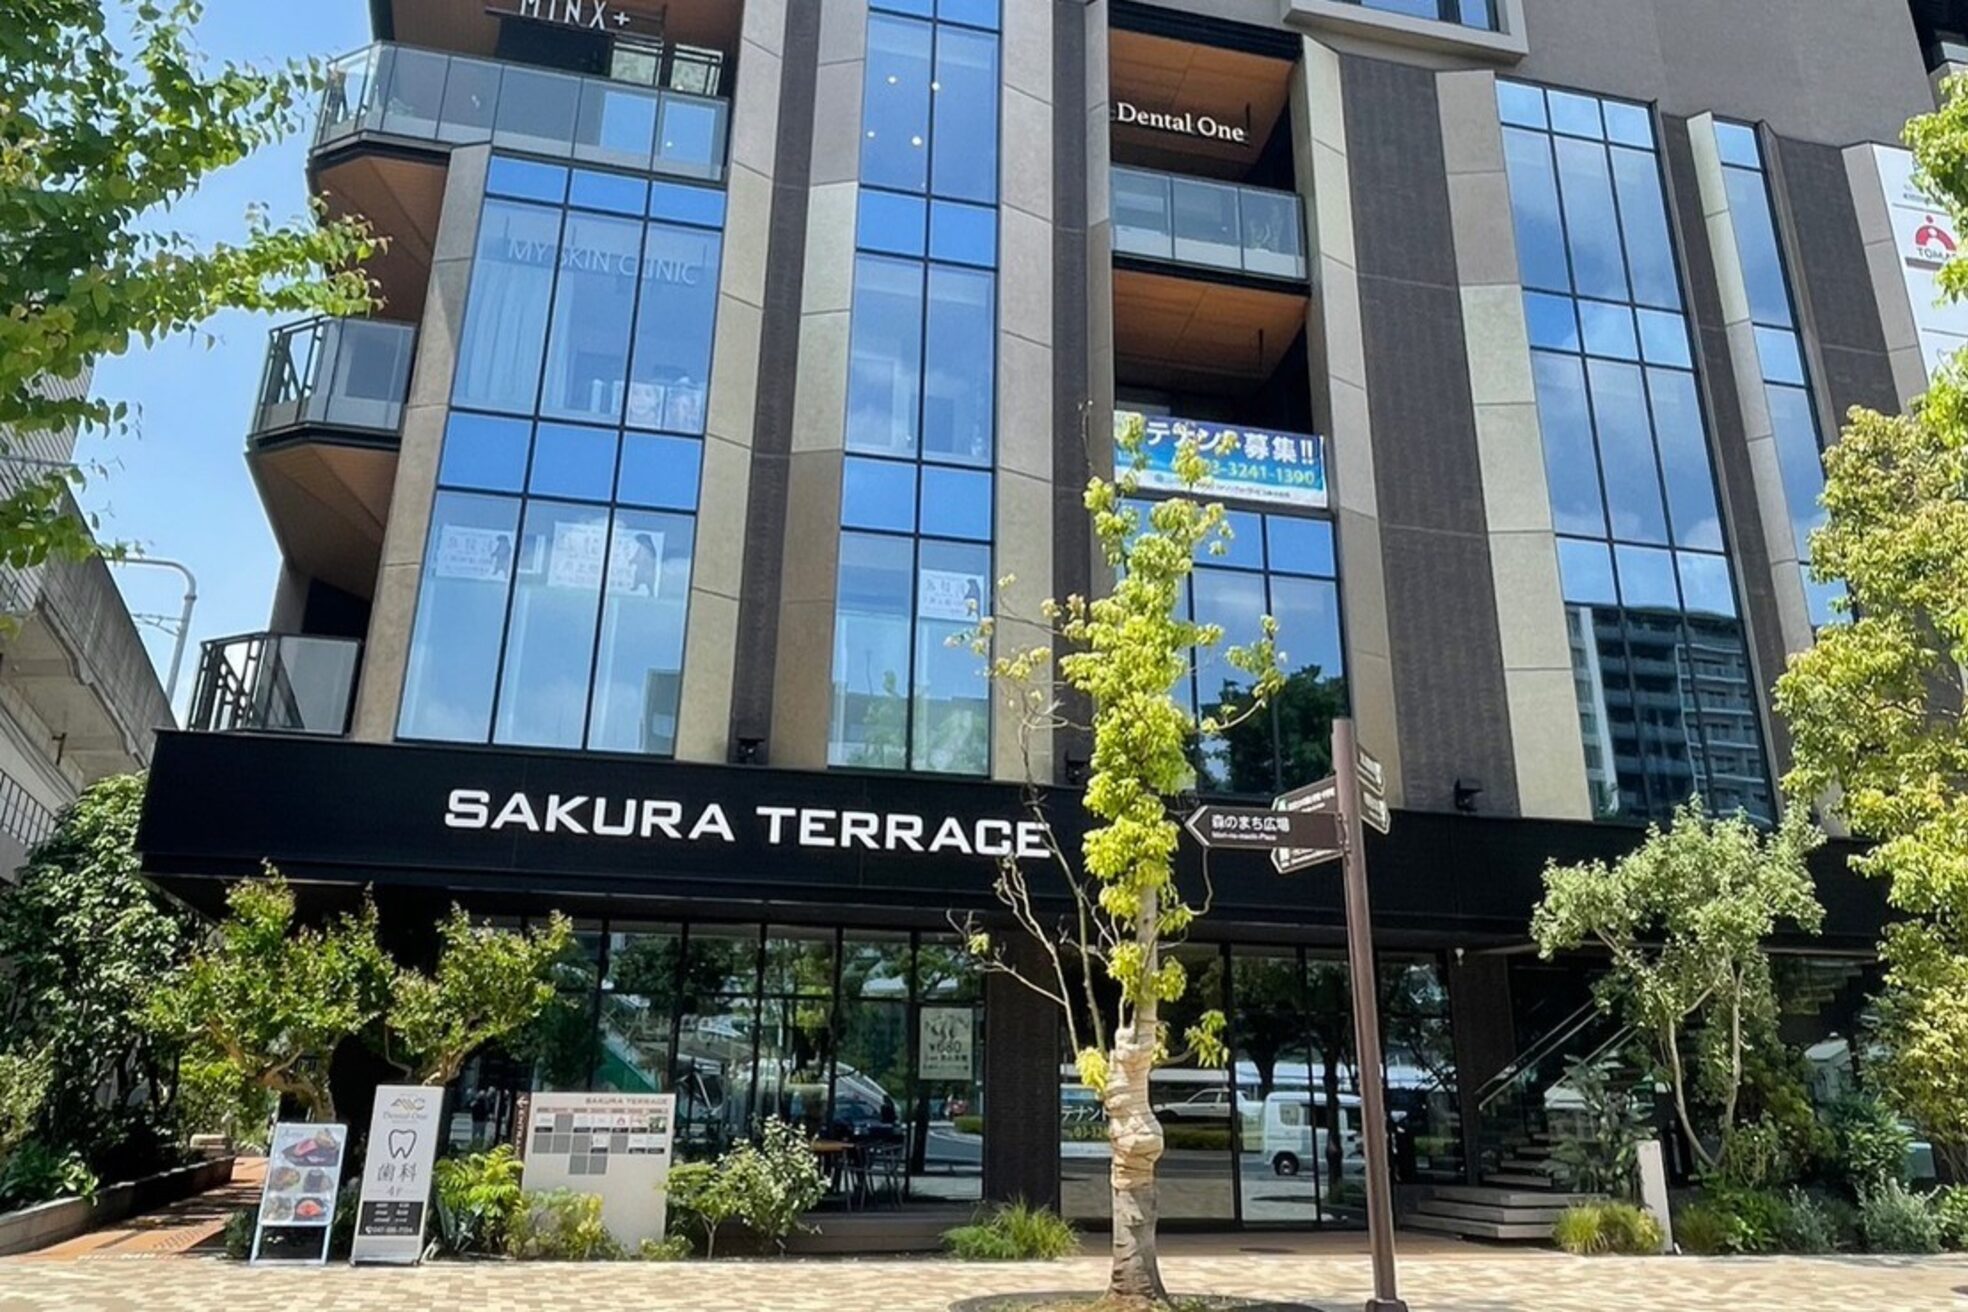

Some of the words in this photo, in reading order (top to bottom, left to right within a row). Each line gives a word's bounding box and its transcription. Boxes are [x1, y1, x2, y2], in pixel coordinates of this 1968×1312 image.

[1117, 102, 1192, 132] Dental
[1197, 116, 1245, 141] One
[508, 239, 550, 263] MY
[1916, 246, 1957, 261] TOMA
[444, 788, 735, 842] SAKURA
[756, 805, 1052, 858] TERRACE
[377, 1162, 417, 1182] 歯科
